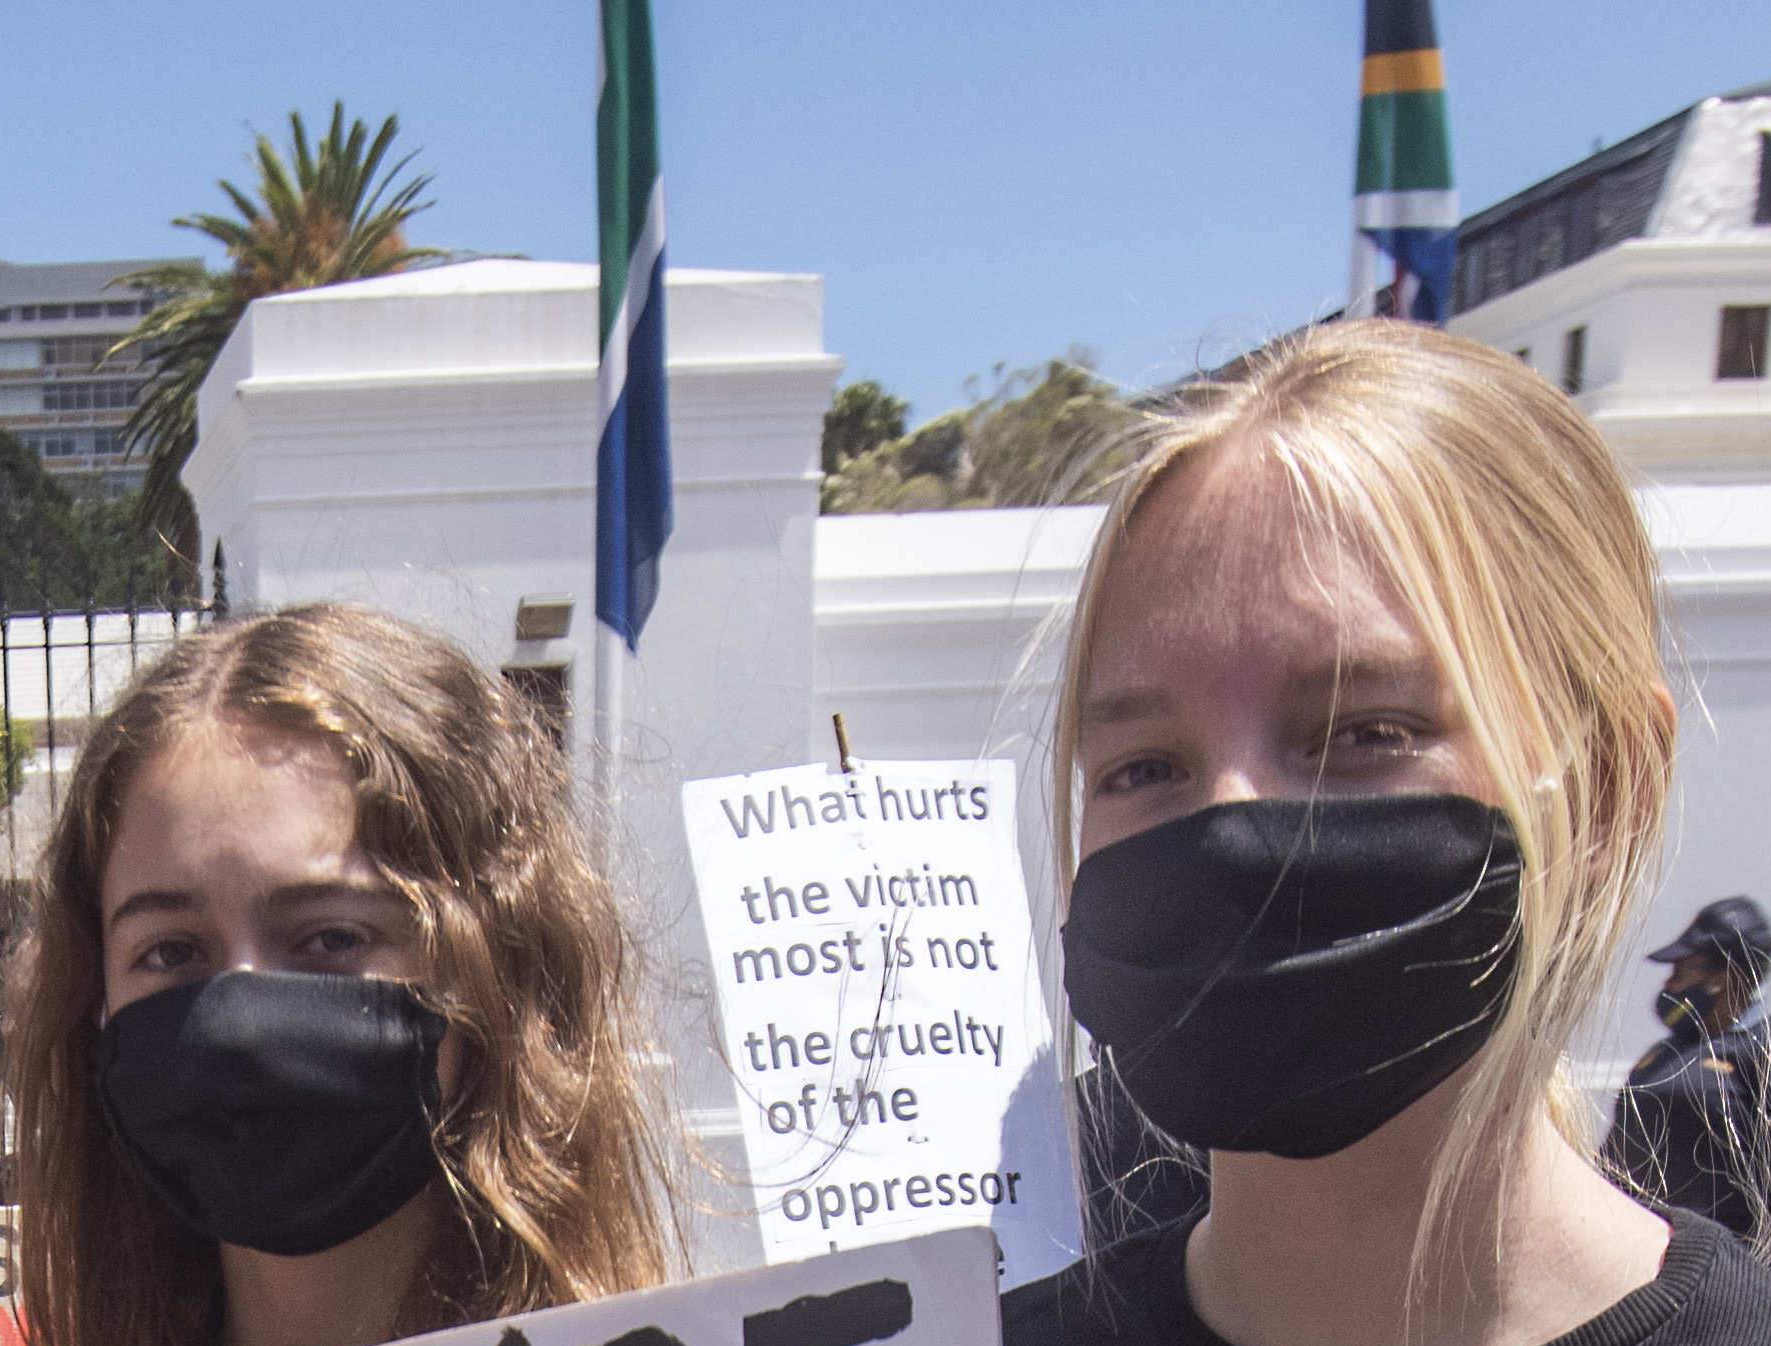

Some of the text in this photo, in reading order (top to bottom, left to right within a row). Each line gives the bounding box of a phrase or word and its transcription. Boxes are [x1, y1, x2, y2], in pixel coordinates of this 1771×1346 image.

[720, 775, 989, 839] What hurts
[740, 862, 980, 925] the victim
[732, 922, 999, 985] most is not
[743, 1009, 1005, 1072] the cruelty
[766, 1079, 920, 1134] of the
[780, 1169, 1022, 1229] oppressor
